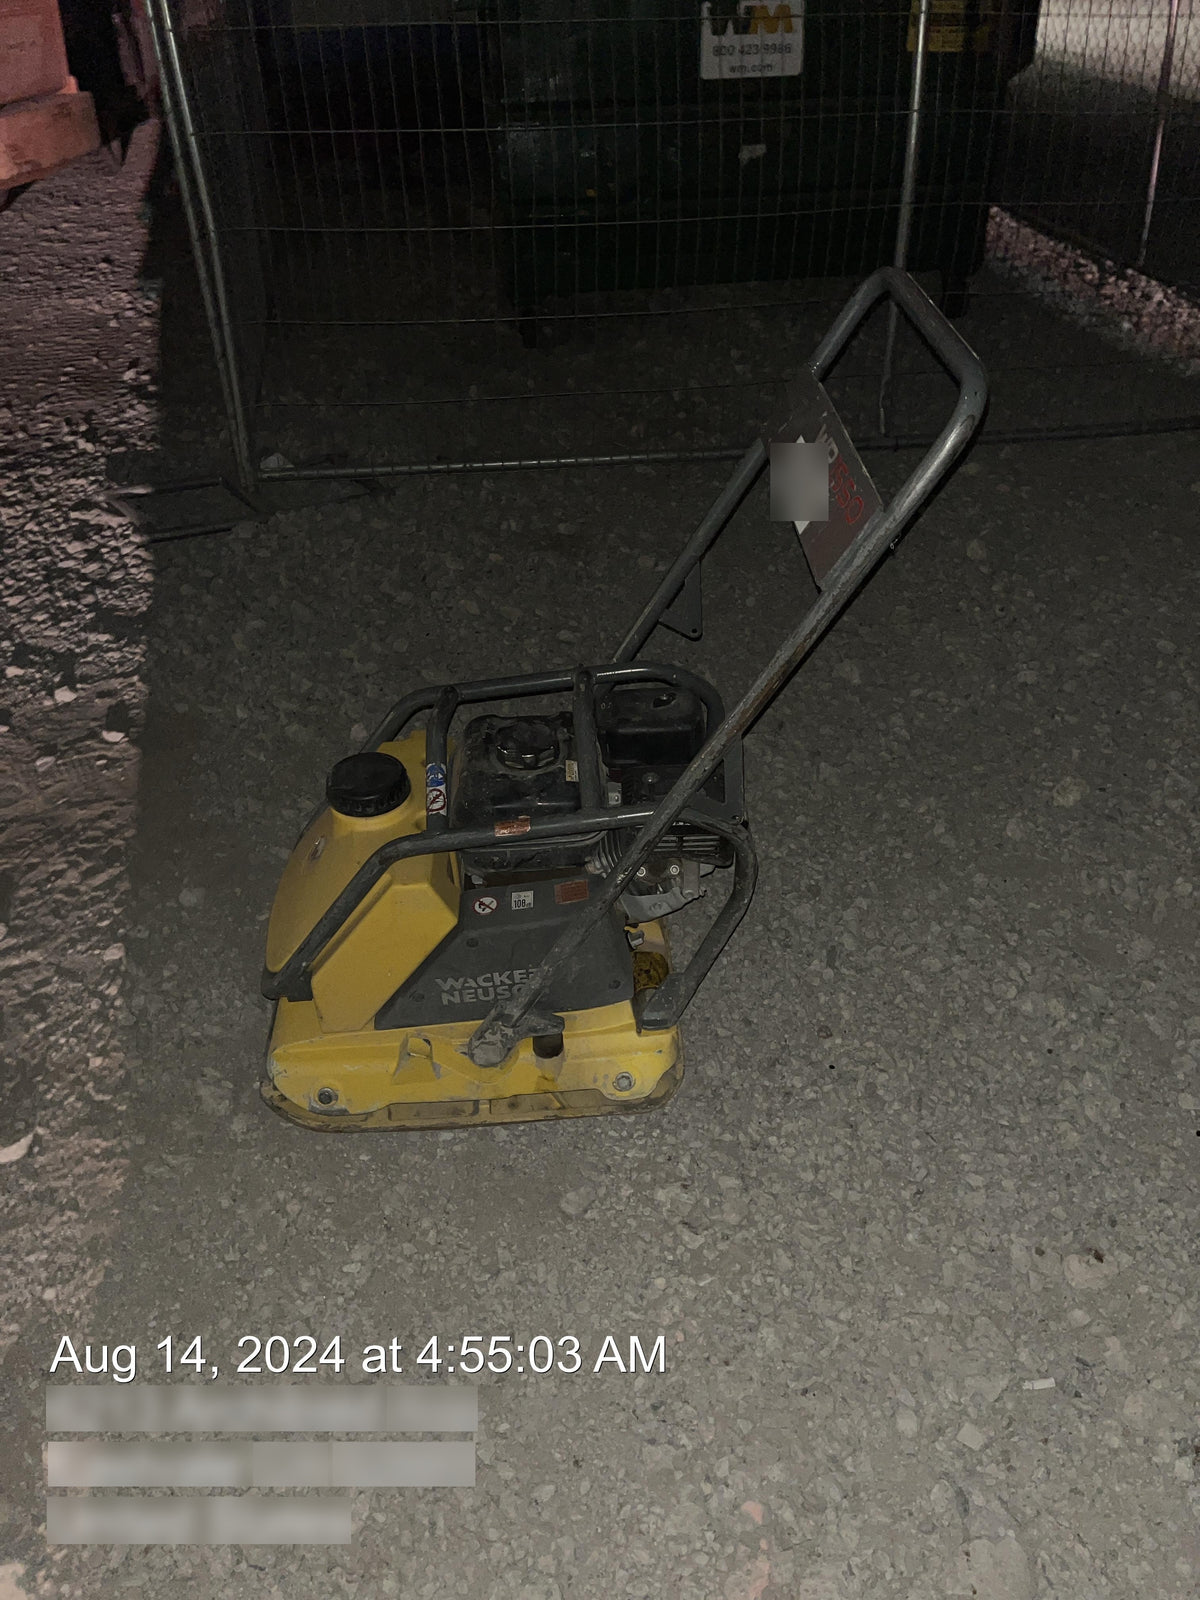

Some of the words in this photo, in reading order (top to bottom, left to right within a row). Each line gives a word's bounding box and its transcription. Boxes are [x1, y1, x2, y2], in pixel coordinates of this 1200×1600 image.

[709, 3, 793, 36] WM
[729, 64, 773, 73] wm.com
[514, 899, 526, 909] 108
